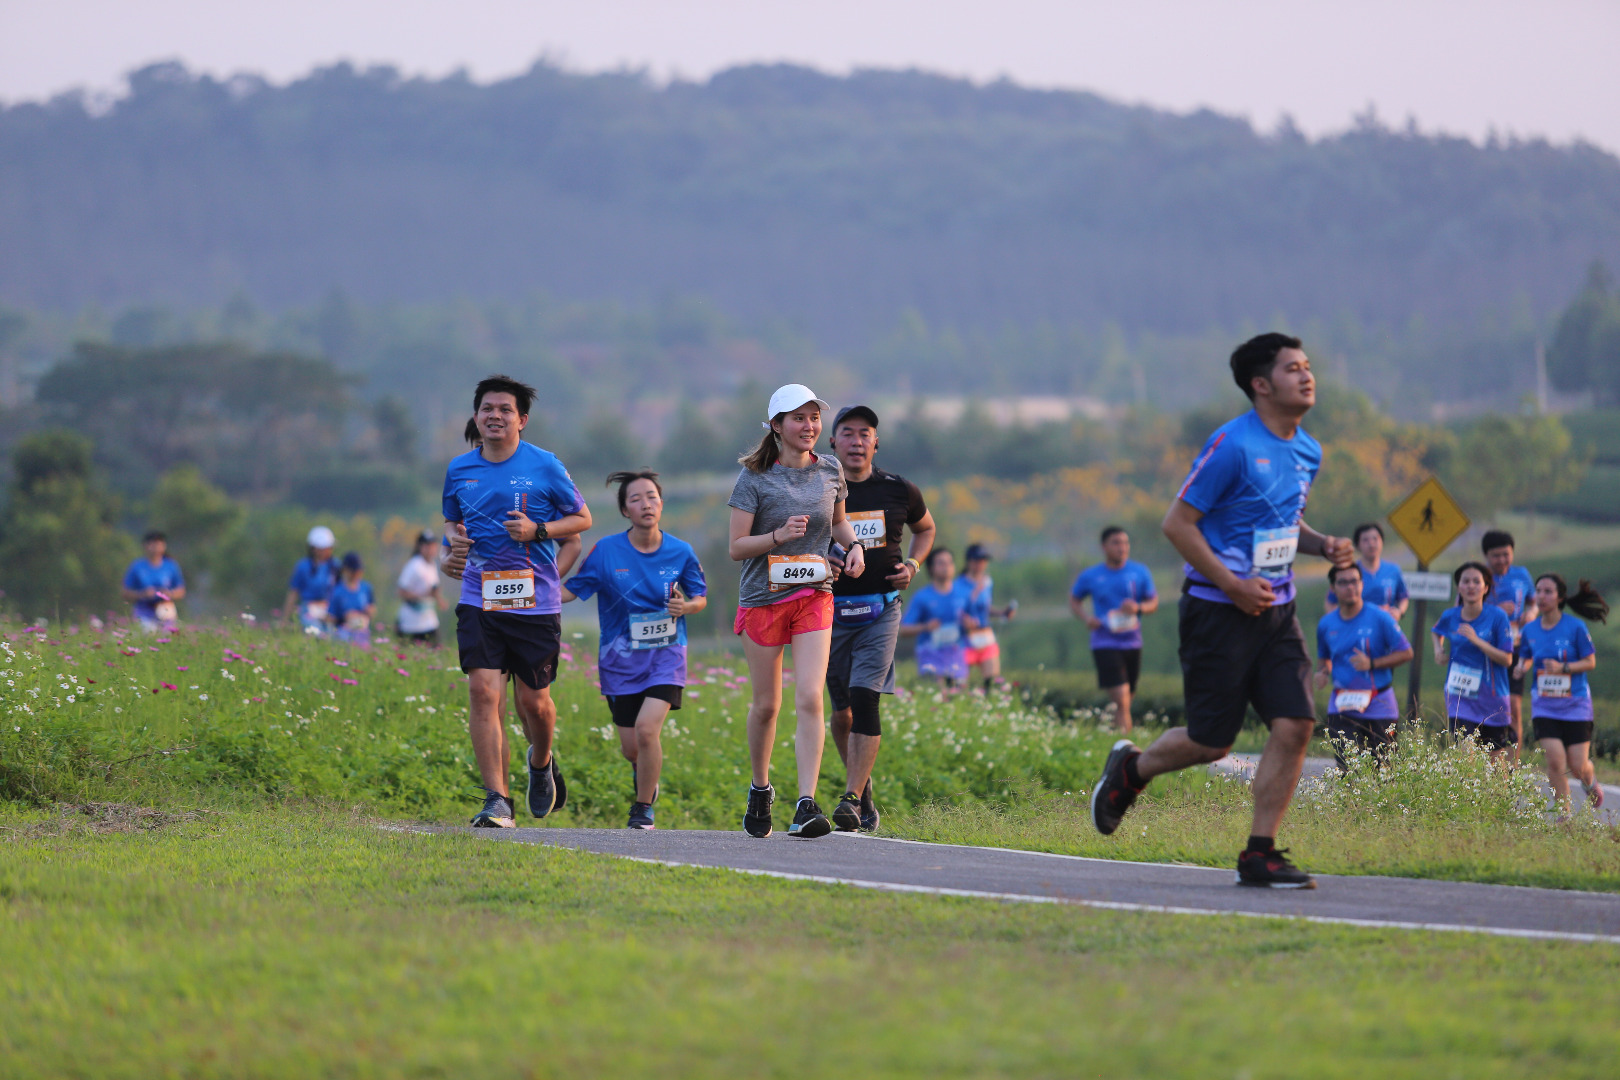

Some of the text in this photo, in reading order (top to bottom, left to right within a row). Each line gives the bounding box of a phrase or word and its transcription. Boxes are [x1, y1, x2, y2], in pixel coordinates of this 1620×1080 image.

[853, 522, 876, 536] 066
[783, 567, 815, 579] 8494
[494, 583, 524, 595] 8559
[642, 623, 668, 636] 5153
